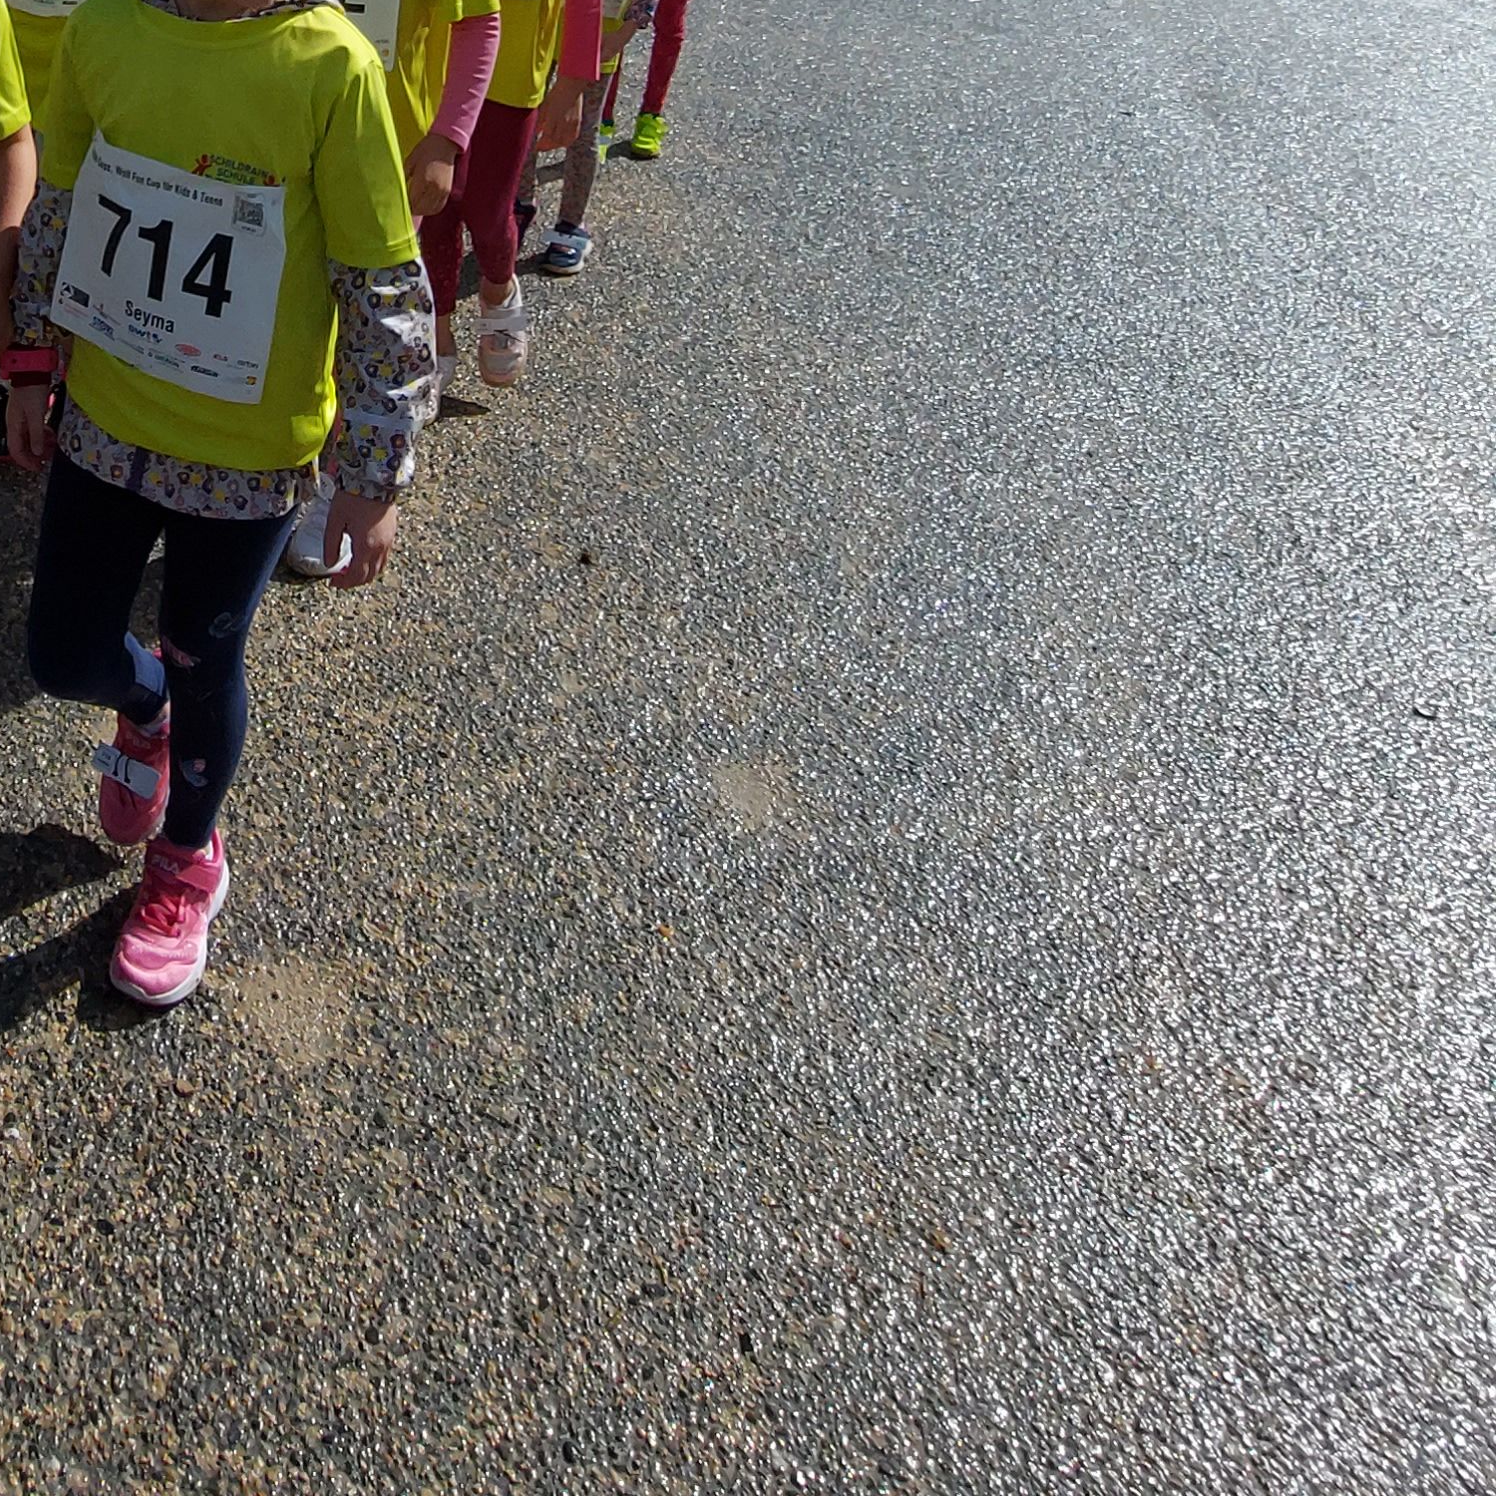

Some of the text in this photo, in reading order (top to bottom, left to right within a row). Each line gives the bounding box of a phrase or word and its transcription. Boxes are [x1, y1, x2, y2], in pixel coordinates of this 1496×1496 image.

[175, 184, 191, 198] Kids
[98, 193, 234, 318] 714
[124, 300, 175, 334] Seyma
[152, 853, 181, 875] FILA
